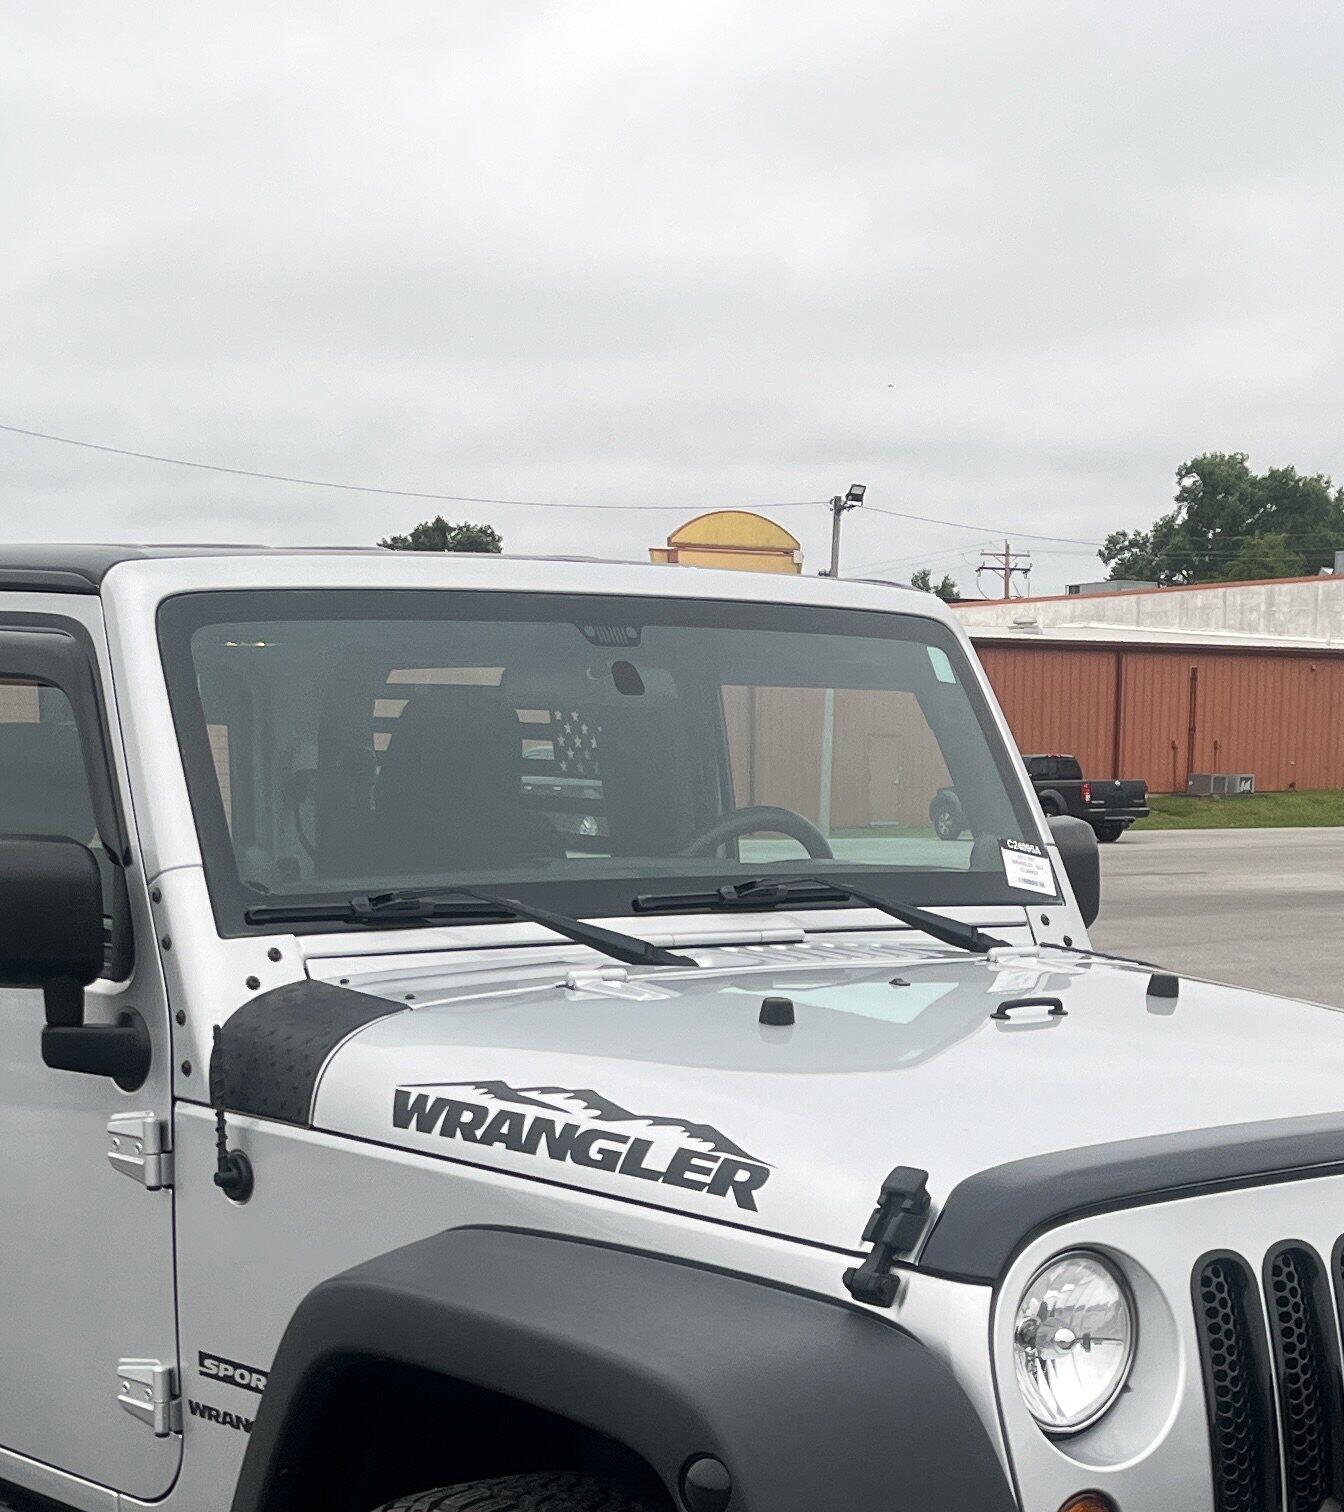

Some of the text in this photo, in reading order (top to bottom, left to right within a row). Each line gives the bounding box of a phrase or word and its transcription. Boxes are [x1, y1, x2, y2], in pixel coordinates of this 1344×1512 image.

[393, 1088, 771, 1212] WRANGLER
[199, 1358, 268, 1391] SPOR
[188, 1399, 256, 1433] WRAN
